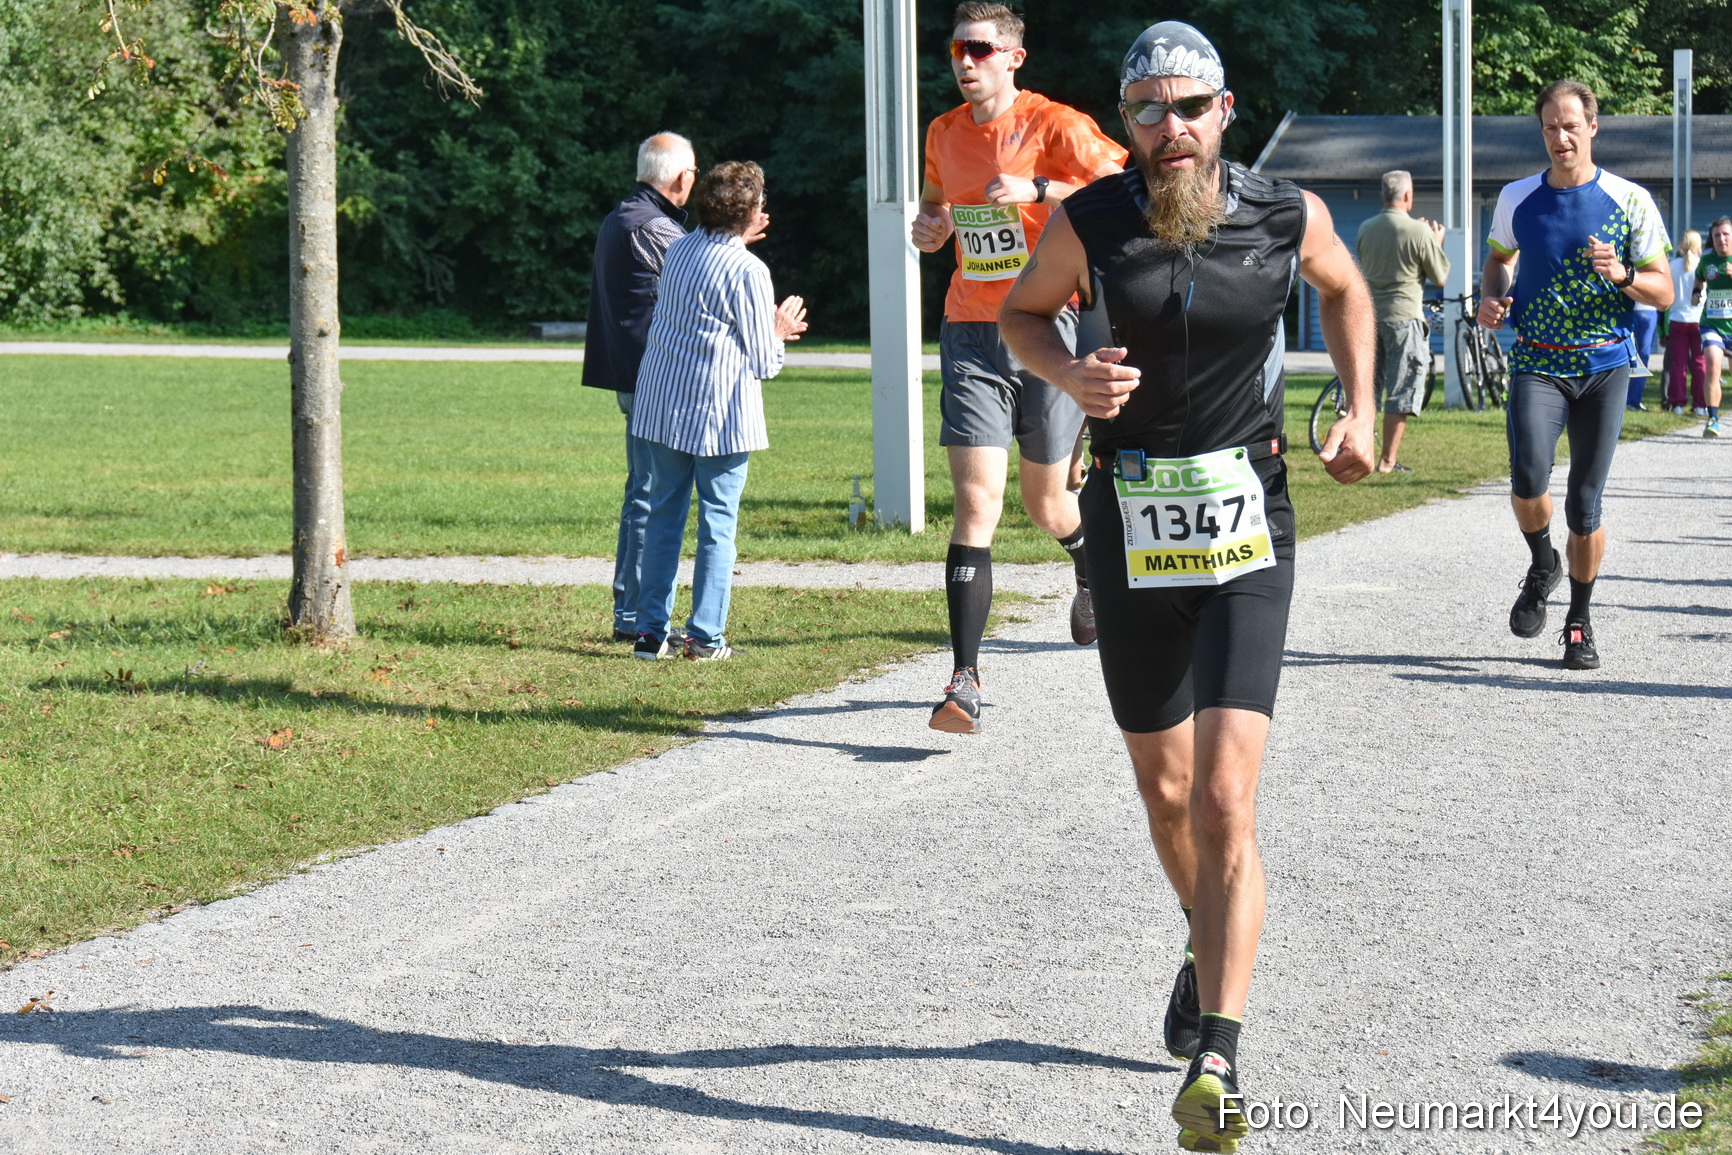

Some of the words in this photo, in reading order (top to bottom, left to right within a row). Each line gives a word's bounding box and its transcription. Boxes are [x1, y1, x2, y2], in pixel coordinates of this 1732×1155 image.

[955, 207, 1009, 223] BOCK
[964, 229, 1015, 254] 1019
[966, 257, 1021, 272] JOHANNES
[1250, 493, 1257, 501] B
[1140, 494, 1246, 541] 1347
[1145, 544, 1254, 571] MATTHIAS
